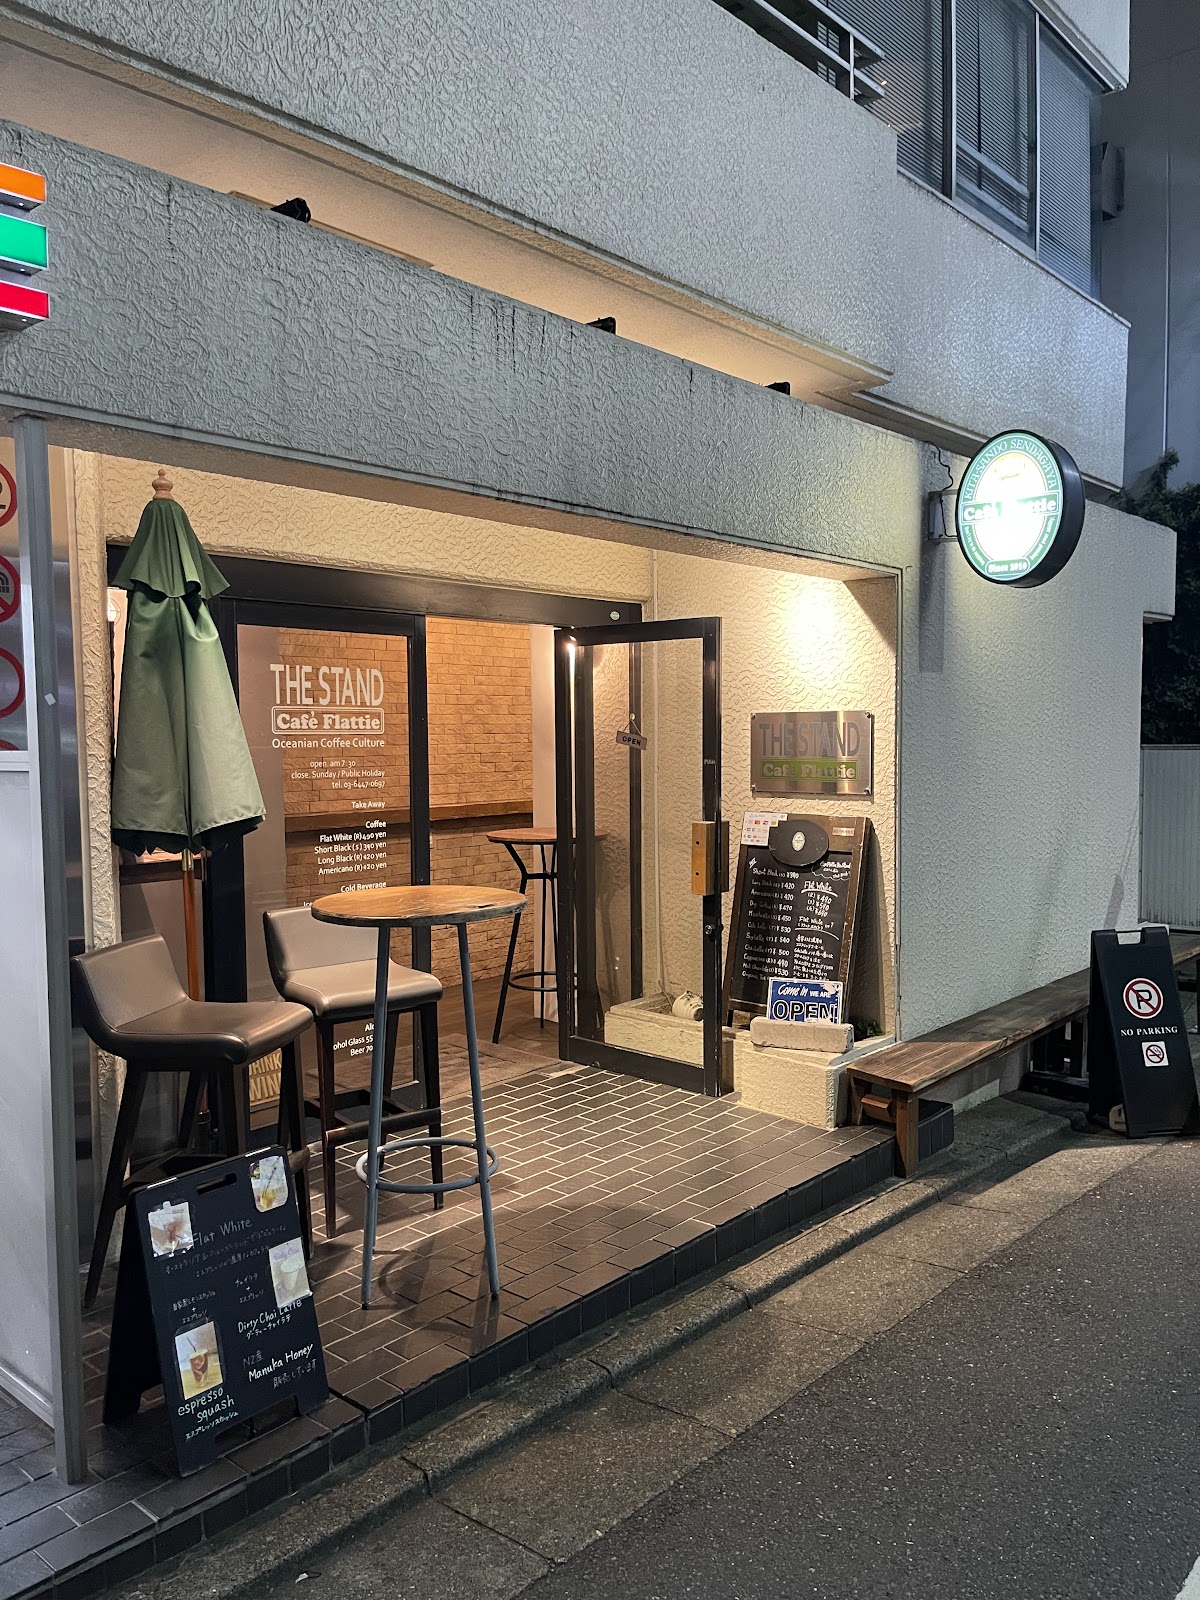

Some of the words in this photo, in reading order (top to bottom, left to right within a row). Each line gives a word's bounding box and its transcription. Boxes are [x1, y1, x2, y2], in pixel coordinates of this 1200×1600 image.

[964, 441, 1007, 499] KITA-SANDO
[1010, 439, 1057, 489] SENDAGAYA
[270, 664, 314, 705] THE
[319, 665, 384, 706] STAND
[322, 714, 381, 730] Flattie
[272, 738, 319, 749] Oceanian
[320, 737, 351, 748] Coffee
[352, 738, 385, 748] Culture
[622, 735, 641, 746] OPEN
[758, 722, 794, 757] THE
[798, 721, 860, 757] STAND
[341, 760, 356, 768] 7:30
[312, 770, 336, 779] Sunday
[341, 769, 361, 778] Public
[361, 769, 385, 779] Holiday
[801, 764, 856, 779] Flattie
[351, 801, 367, 809] Take
[367, 801, 385, 809] Away
[365, 820, 387, 829] Coffee
[319, 834, 333, 843] Flat
[333, 832, 353, 841] White
[375, 831, 387, 840] yen
[314, 845, 333, 854] Short
[333, 843, 352, 852] Black
[375, 841, 387, 850] yen
[317, 856, 335, 865] Long
[335, 854, 353, 863] Black
[375, 852, 387, 861] yen
[318, 865, 354, 875] Americano
[375, 861, 387, 870] yen
[340, 884, 356, 893] Cold
[356, 881, 387, 891] Beverage
[778, 984, 800, 996] Come
[800, 985, 809, 997] in
[809, 990, 820, 998] WE
[772, 1000, 835, 1023] OPEN
[1120, 1028, 1134, 1037] NO
[1136, 1025, 1178, 1036] PARKING
[347, 1036, 365, 1047] Glass
[350, 1046, 365, 1057] Beer
[192, 1231, 216, 1247] Flat
[220, 1219, 253, 1236] White
[259, 1308, 277, 1324] Chai
[279, 1298, 303, 1316] Latte
[248, 1357, 284, 1383] Manuka
[284, 1343, 314, 1363] Honey
[177, 1386, 224, 1417] espresso
[196, 1394, 235, 1423] squash
